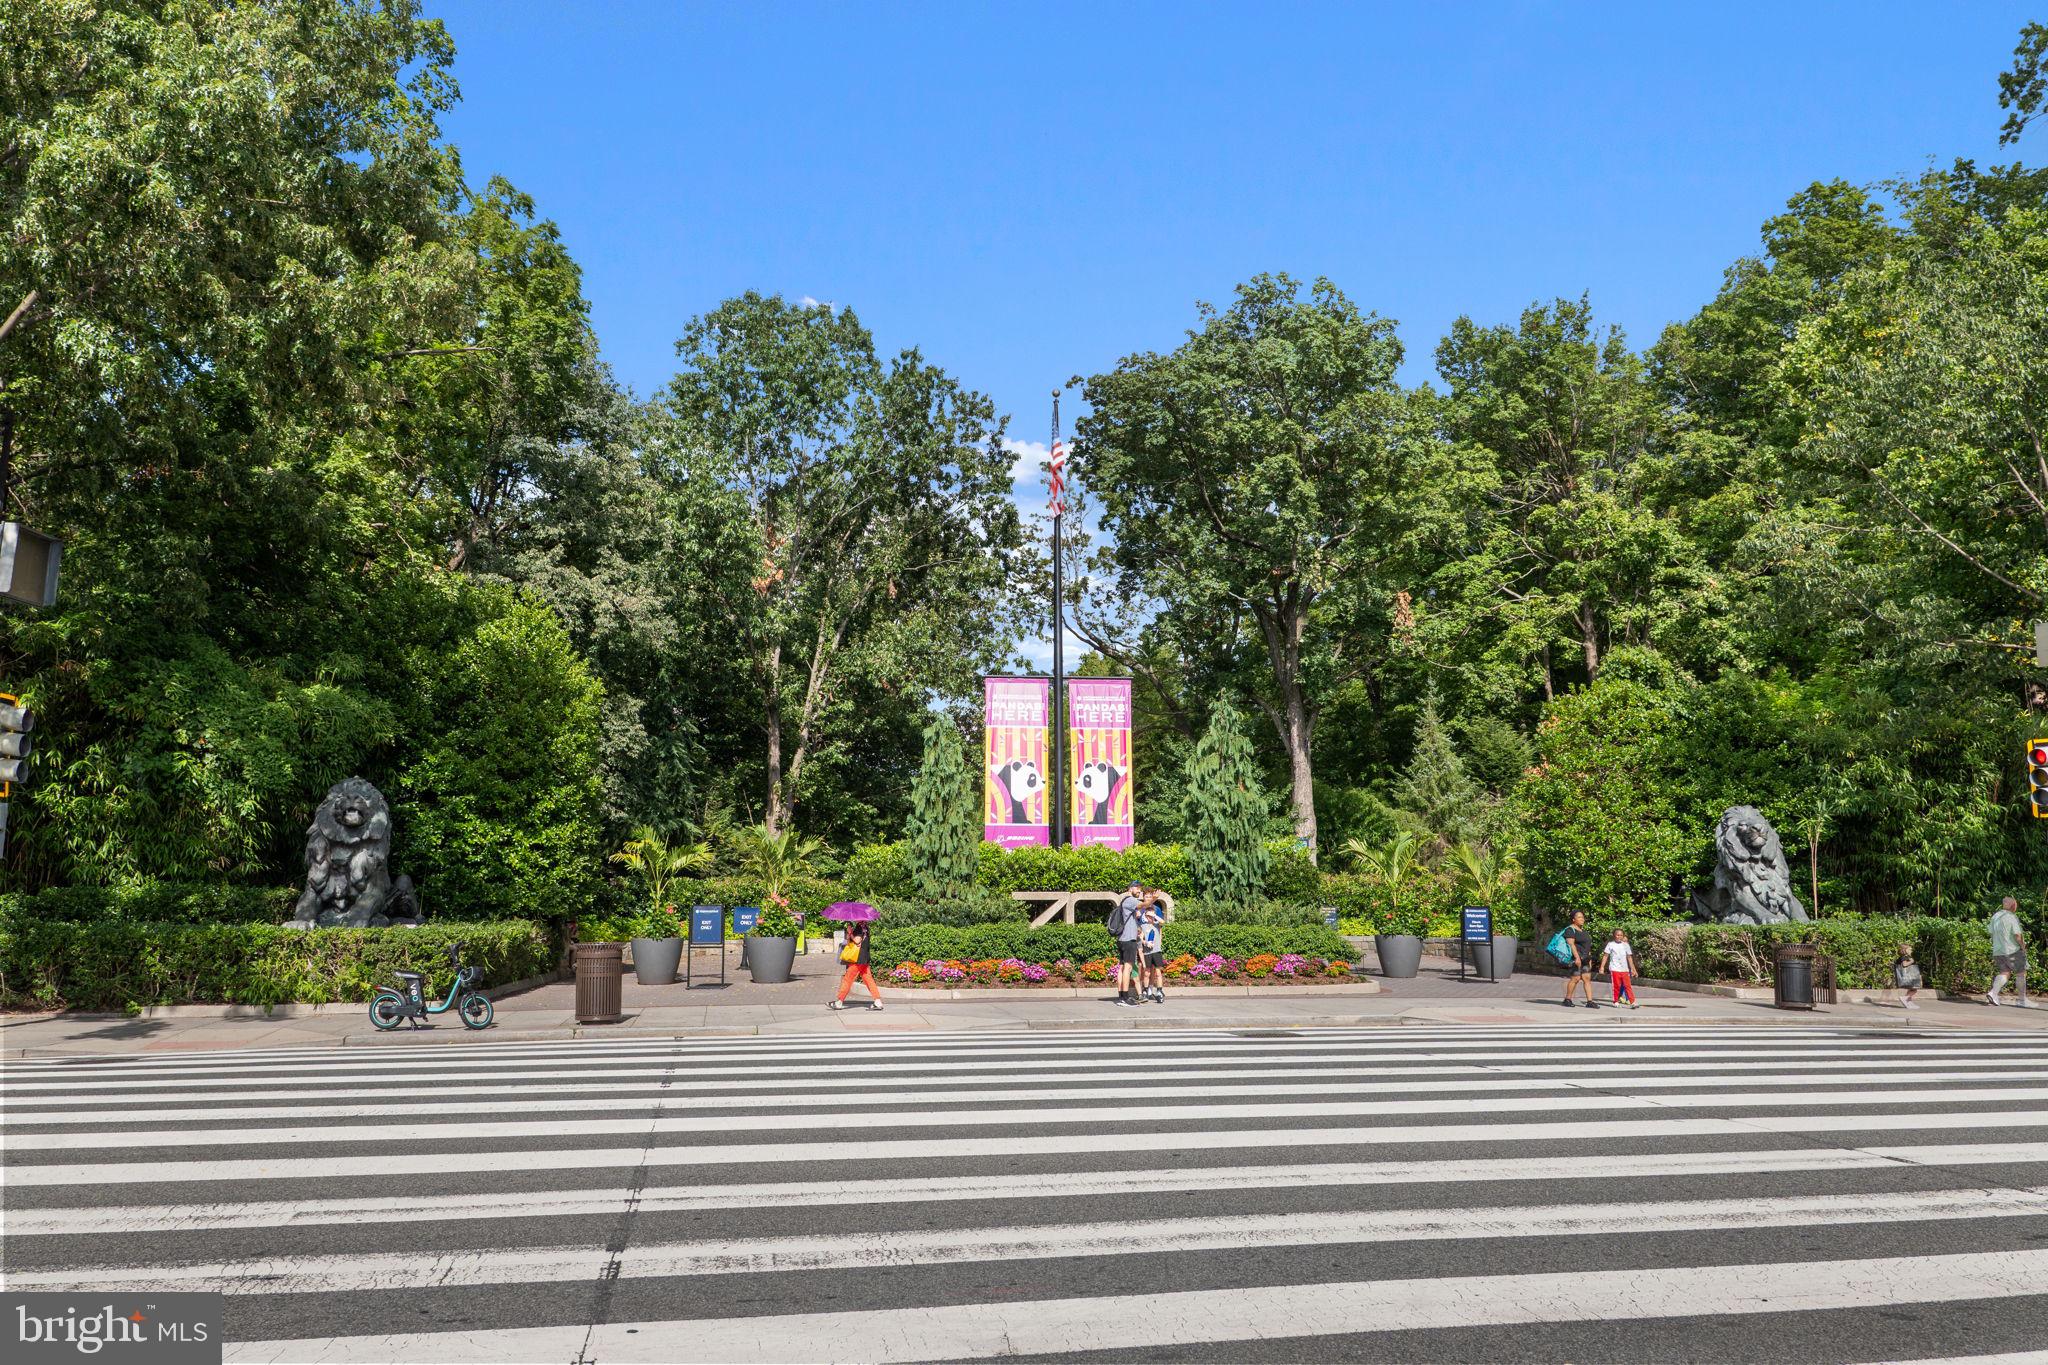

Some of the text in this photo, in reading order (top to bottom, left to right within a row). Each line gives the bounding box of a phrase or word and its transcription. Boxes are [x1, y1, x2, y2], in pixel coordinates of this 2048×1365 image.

[993, 710, 1042, 721] HERE
[1076, 711, 1125, 722] HERE
[410, 983, 418, 1001] veo
